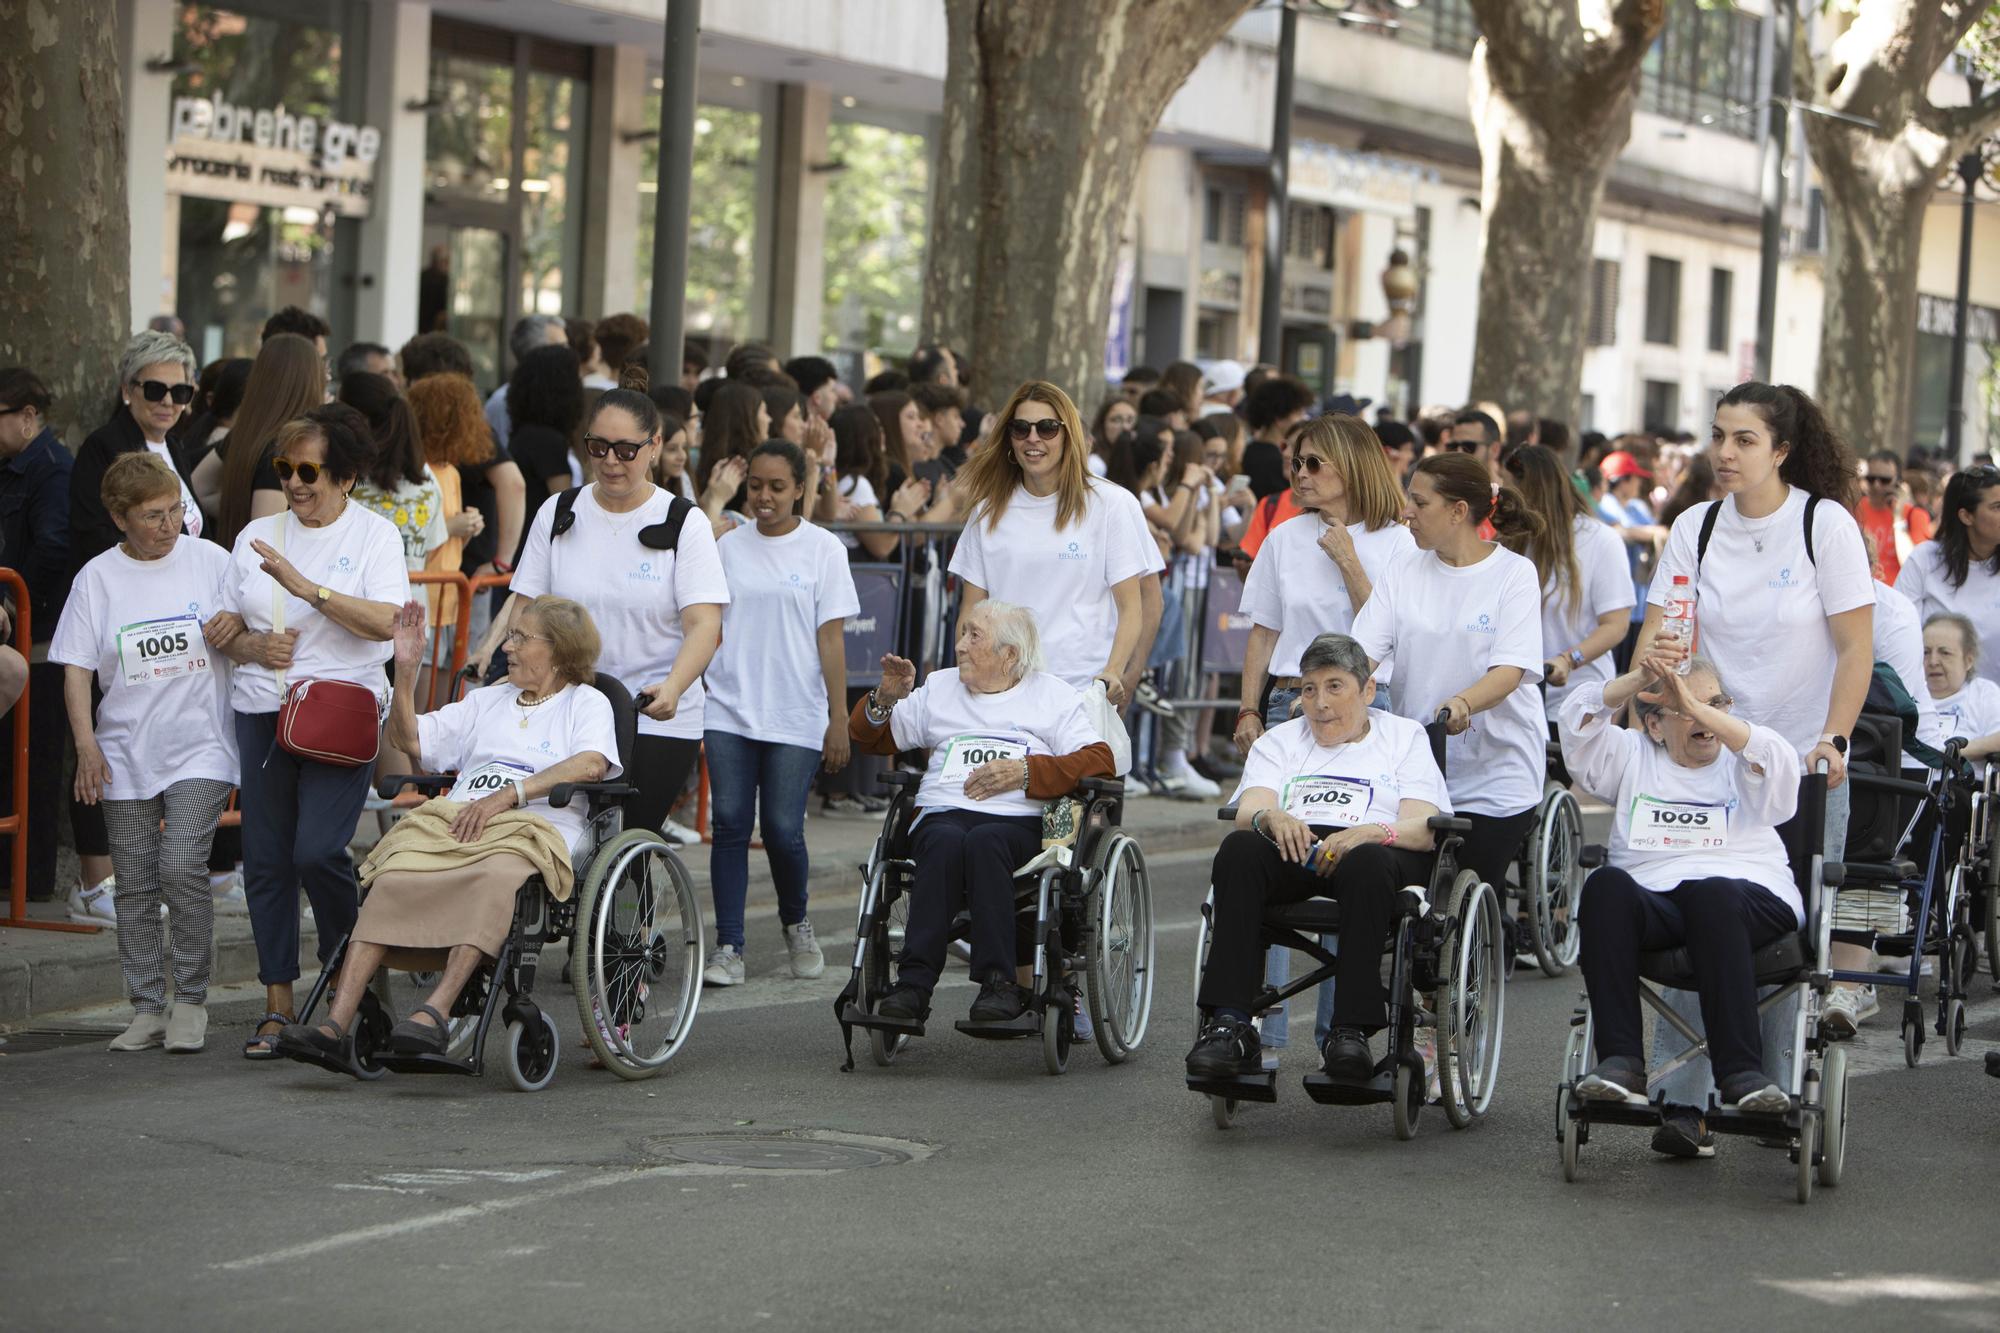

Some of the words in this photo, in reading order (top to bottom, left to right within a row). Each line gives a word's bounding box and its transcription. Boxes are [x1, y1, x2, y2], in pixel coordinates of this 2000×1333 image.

[136, 632, 189, 658] 1005
[1302, 790, 1354, 805] 1005
[1651, 809, 1709, 826] 1005
